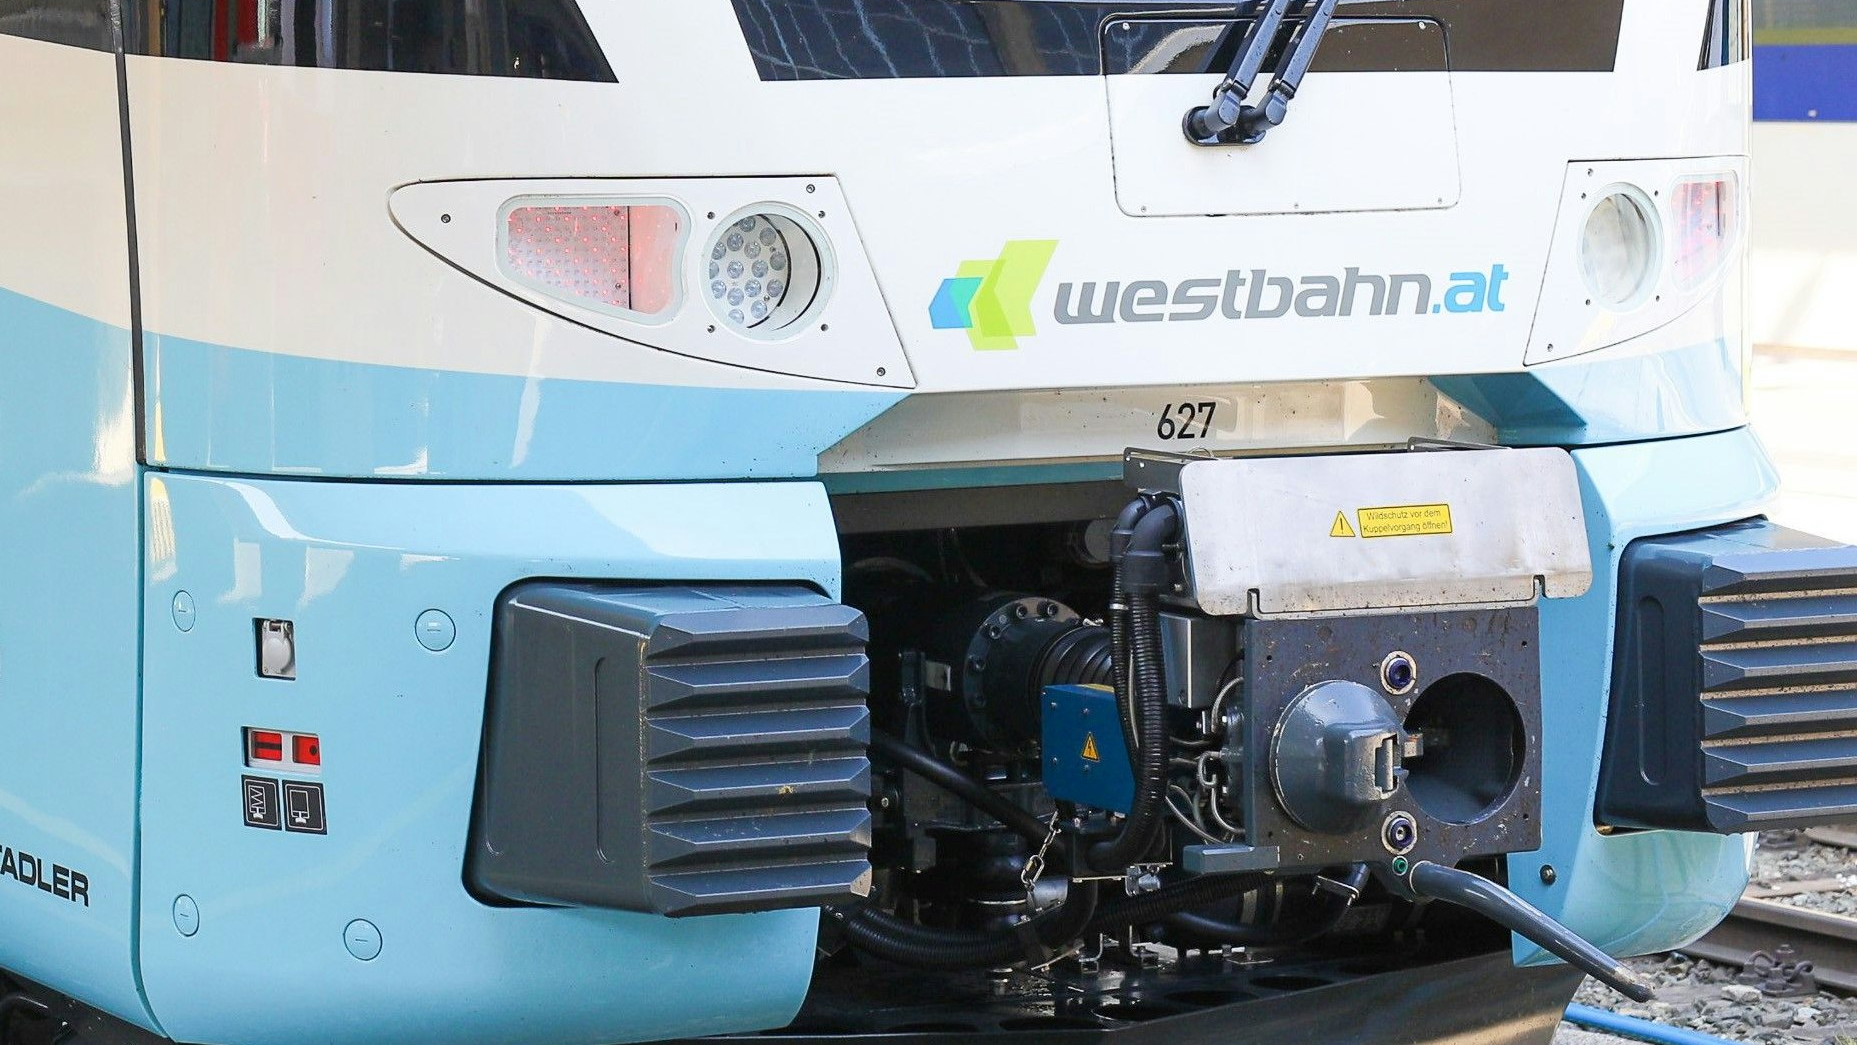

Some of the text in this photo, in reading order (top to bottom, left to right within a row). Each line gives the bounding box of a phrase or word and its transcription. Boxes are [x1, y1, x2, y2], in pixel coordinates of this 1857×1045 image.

[1053, 263, 1509, 325] westbahn.at
[1157, 401, 1217, 440] 627
[1363, 522, 1421, 533] Kuppelvorgang
[1366, 511, 1408, 521] Wildschutz
[1424, 509, 1441, 518] dem
